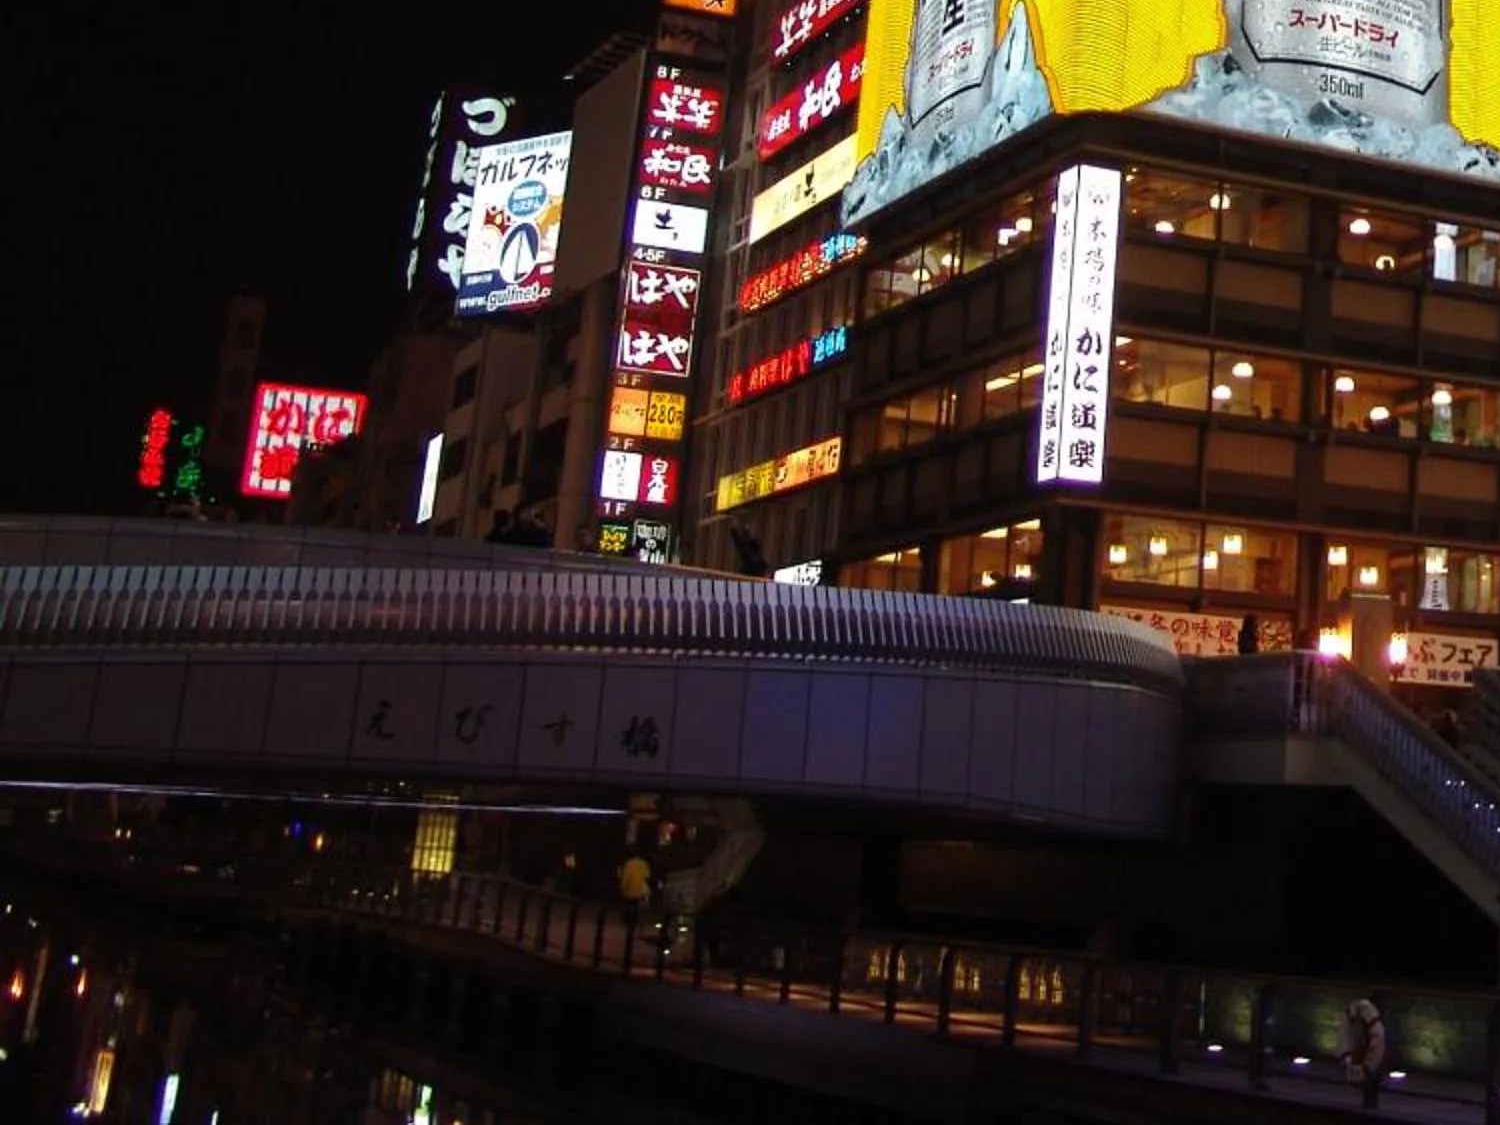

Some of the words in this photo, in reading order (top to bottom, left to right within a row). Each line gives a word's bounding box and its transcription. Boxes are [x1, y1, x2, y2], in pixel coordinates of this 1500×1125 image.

[1289, 9, 1399, 47] スーパードライ
[657, 65, 681, 81] 8F
[629, 269, 697, 309] はや
[621, 330, 689, 371] はや
[1069, 326, 1102, 468] かに道楽
